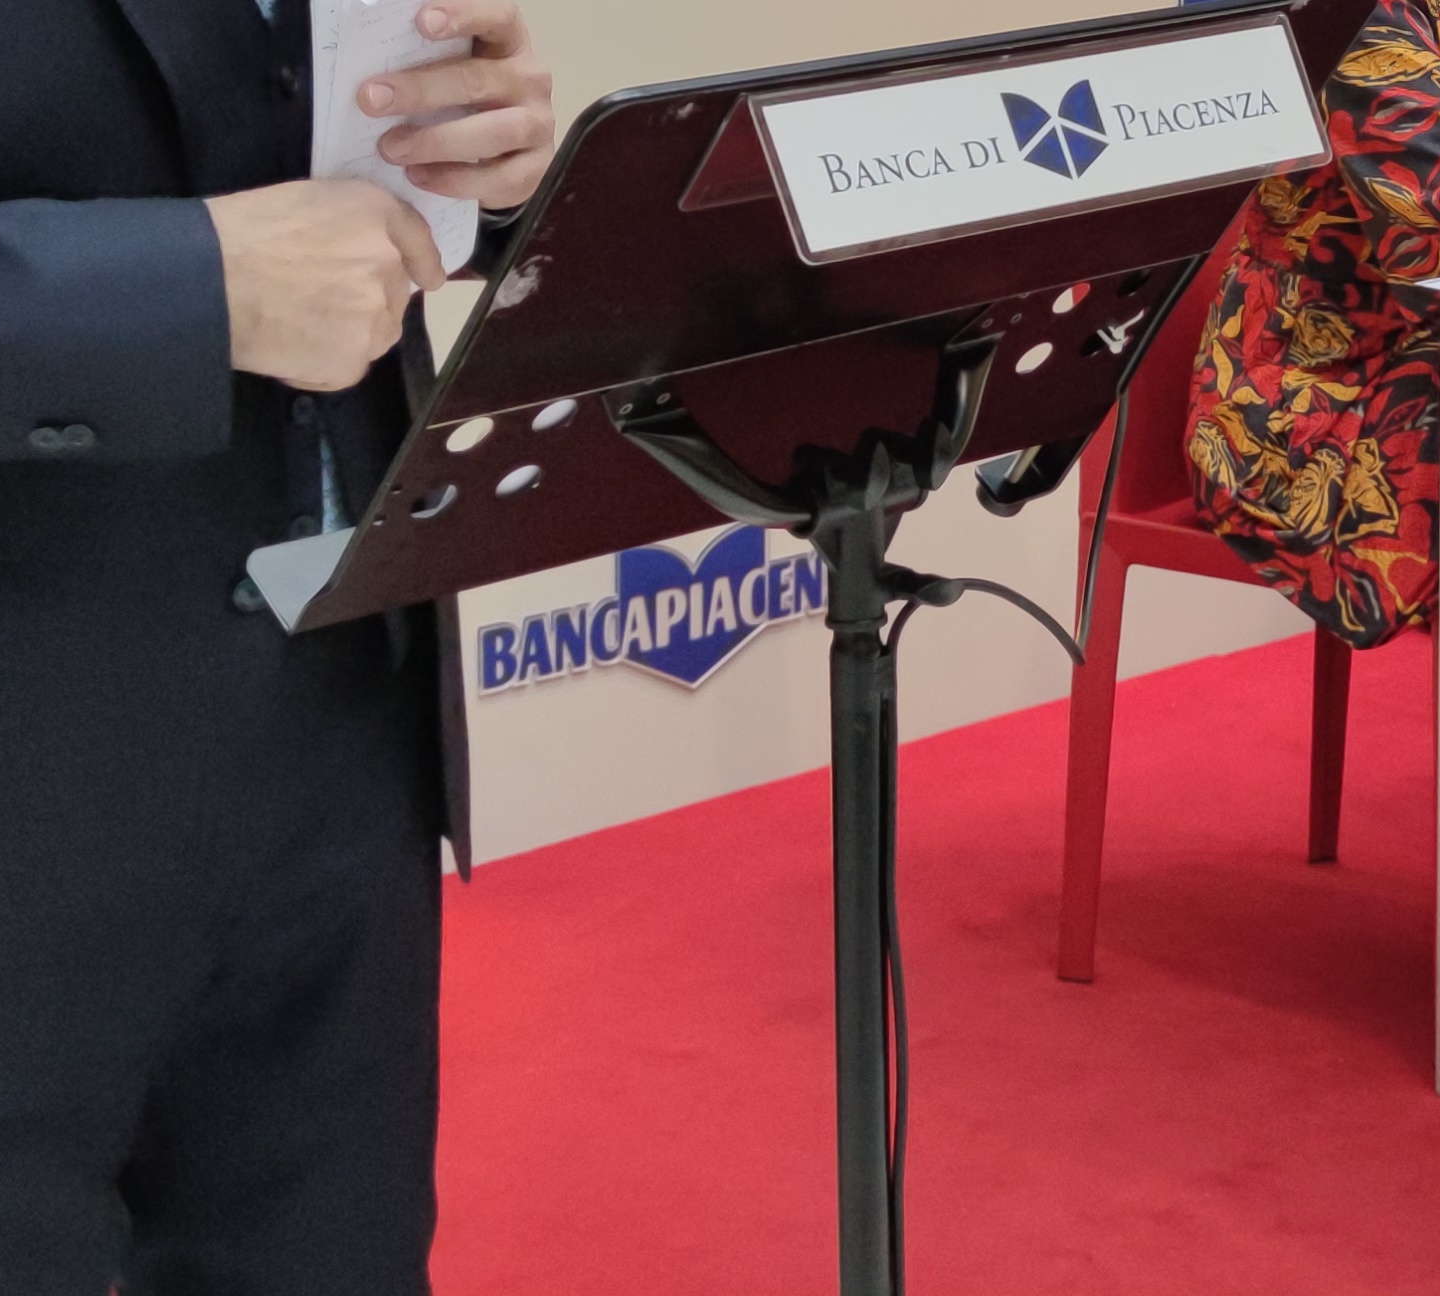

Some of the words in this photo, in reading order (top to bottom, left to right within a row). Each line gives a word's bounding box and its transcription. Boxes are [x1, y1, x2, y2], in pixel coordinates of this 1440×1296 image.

[819, 144, 956, 195] BANCA
[961, 136, 1006, 170] DI
[1112, 88, 1281, 142] PIACENZA
[482, 554, 824, 689] BANCAPIACEN
